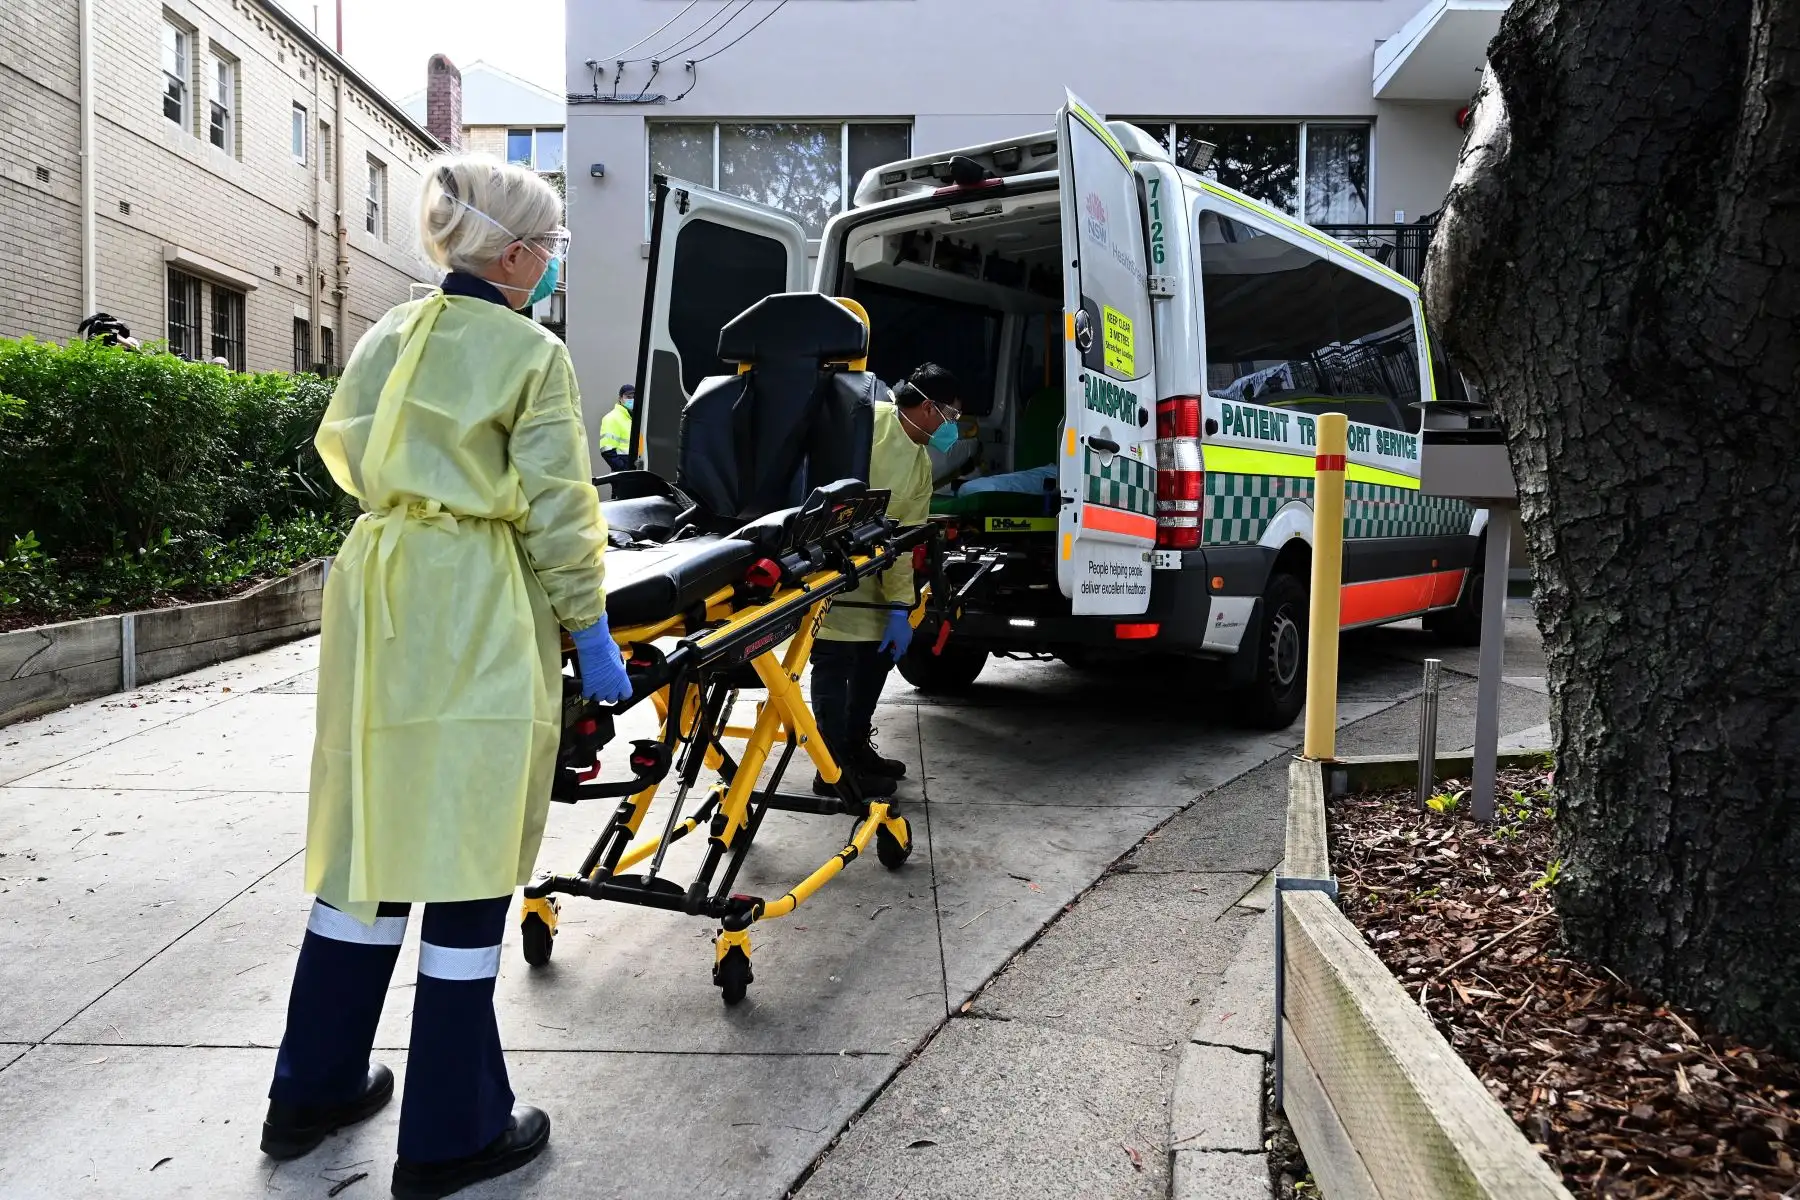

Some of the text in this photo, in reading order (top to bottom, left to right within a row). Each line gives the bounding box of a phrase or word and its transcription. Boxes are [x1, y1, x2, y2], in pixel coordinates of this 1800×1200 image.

[1088, 217, 1106, 244] NSW
[1148, 178, 1165, 265] 7126
[1107, 312, 1131, 333] KEEP CLEAR
[1113, 329, 1130, 347] METRES
[1221, 403, 1417, 460] PATIENT TRORT SERVICE
[1088, 560, 1143, 579] People helping people
[1081, 580, 1146, 594] deliver excellent healthcare
